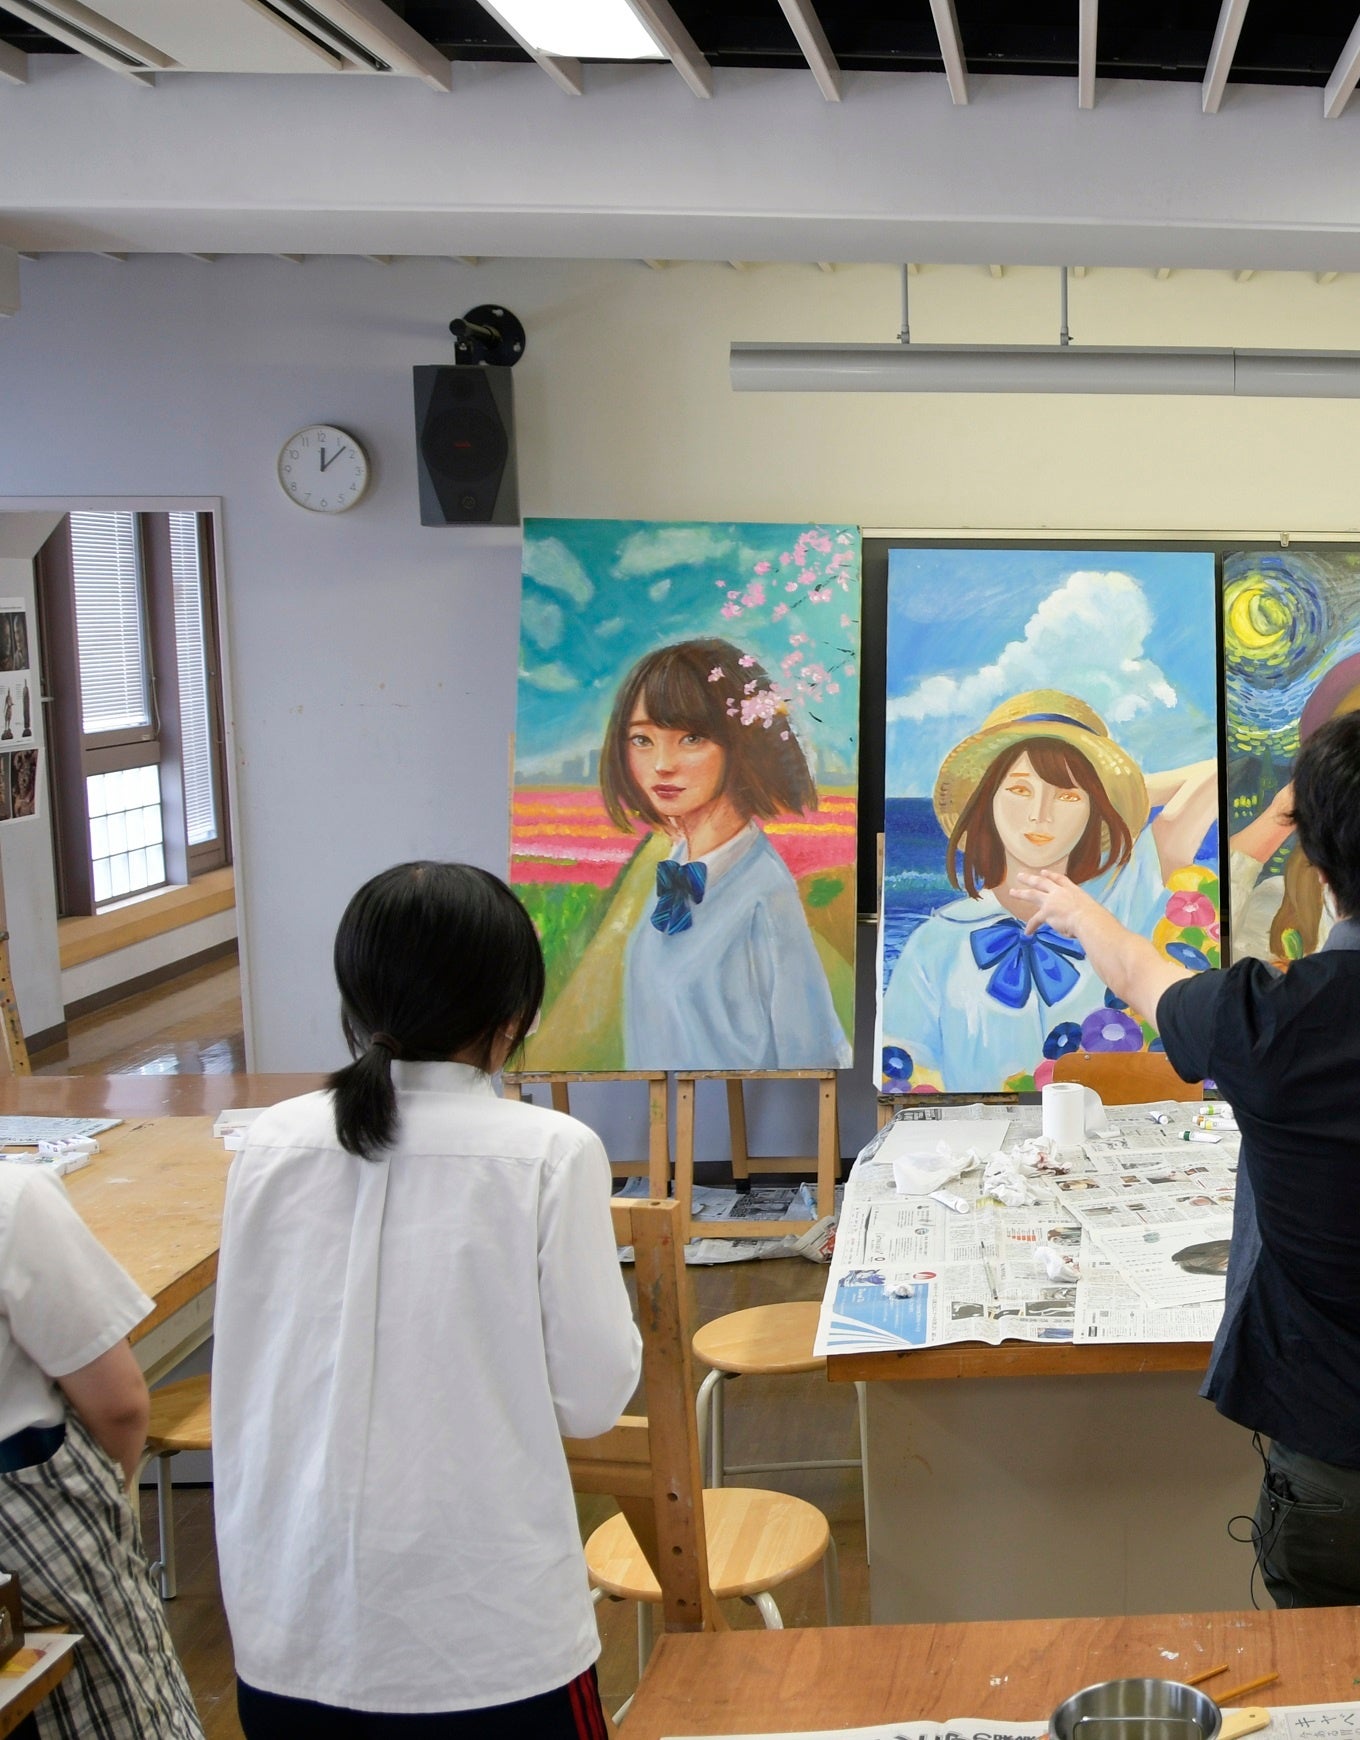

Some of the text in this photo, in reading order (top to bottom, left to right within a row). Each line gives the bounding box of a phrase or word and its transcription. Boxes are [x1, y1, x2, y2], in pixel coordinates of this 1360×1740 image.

[302, 437, 309, 447] 11
[317, 432, 327, 443] 12
[336, 437, 341, 446] 1
[289, 449, 300, 460] 10
[348, 449, 356, 459] 2
[284, 464, 292, 473] 9
[355, 466, 362, 476] 3
[290, 481, 297, 491] 8
[349, 483, 357, 491] 4
[304, 492, 312, 502] 7
[320, 497, 328, 507] 6
[337, 493, 345, 503] 5
